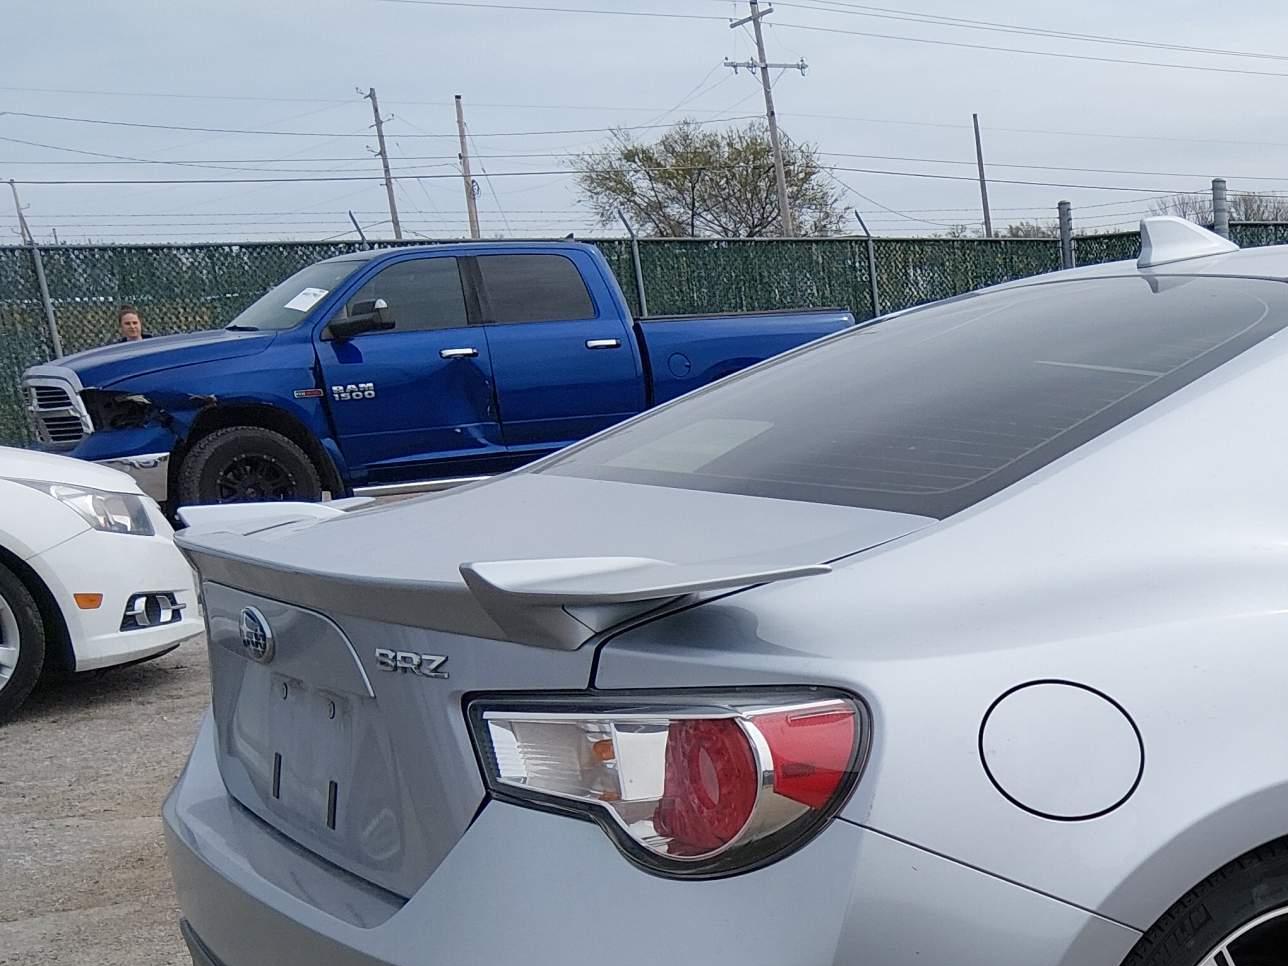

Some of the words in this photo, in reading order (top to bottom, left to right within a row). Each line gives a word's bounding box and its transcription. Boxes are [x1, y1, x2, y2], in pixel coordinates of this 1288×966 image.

[332, 382, 374, 393] RAM
[333, 391, 376, 401] 1500
[375, 648, 450, 680] BRZ
